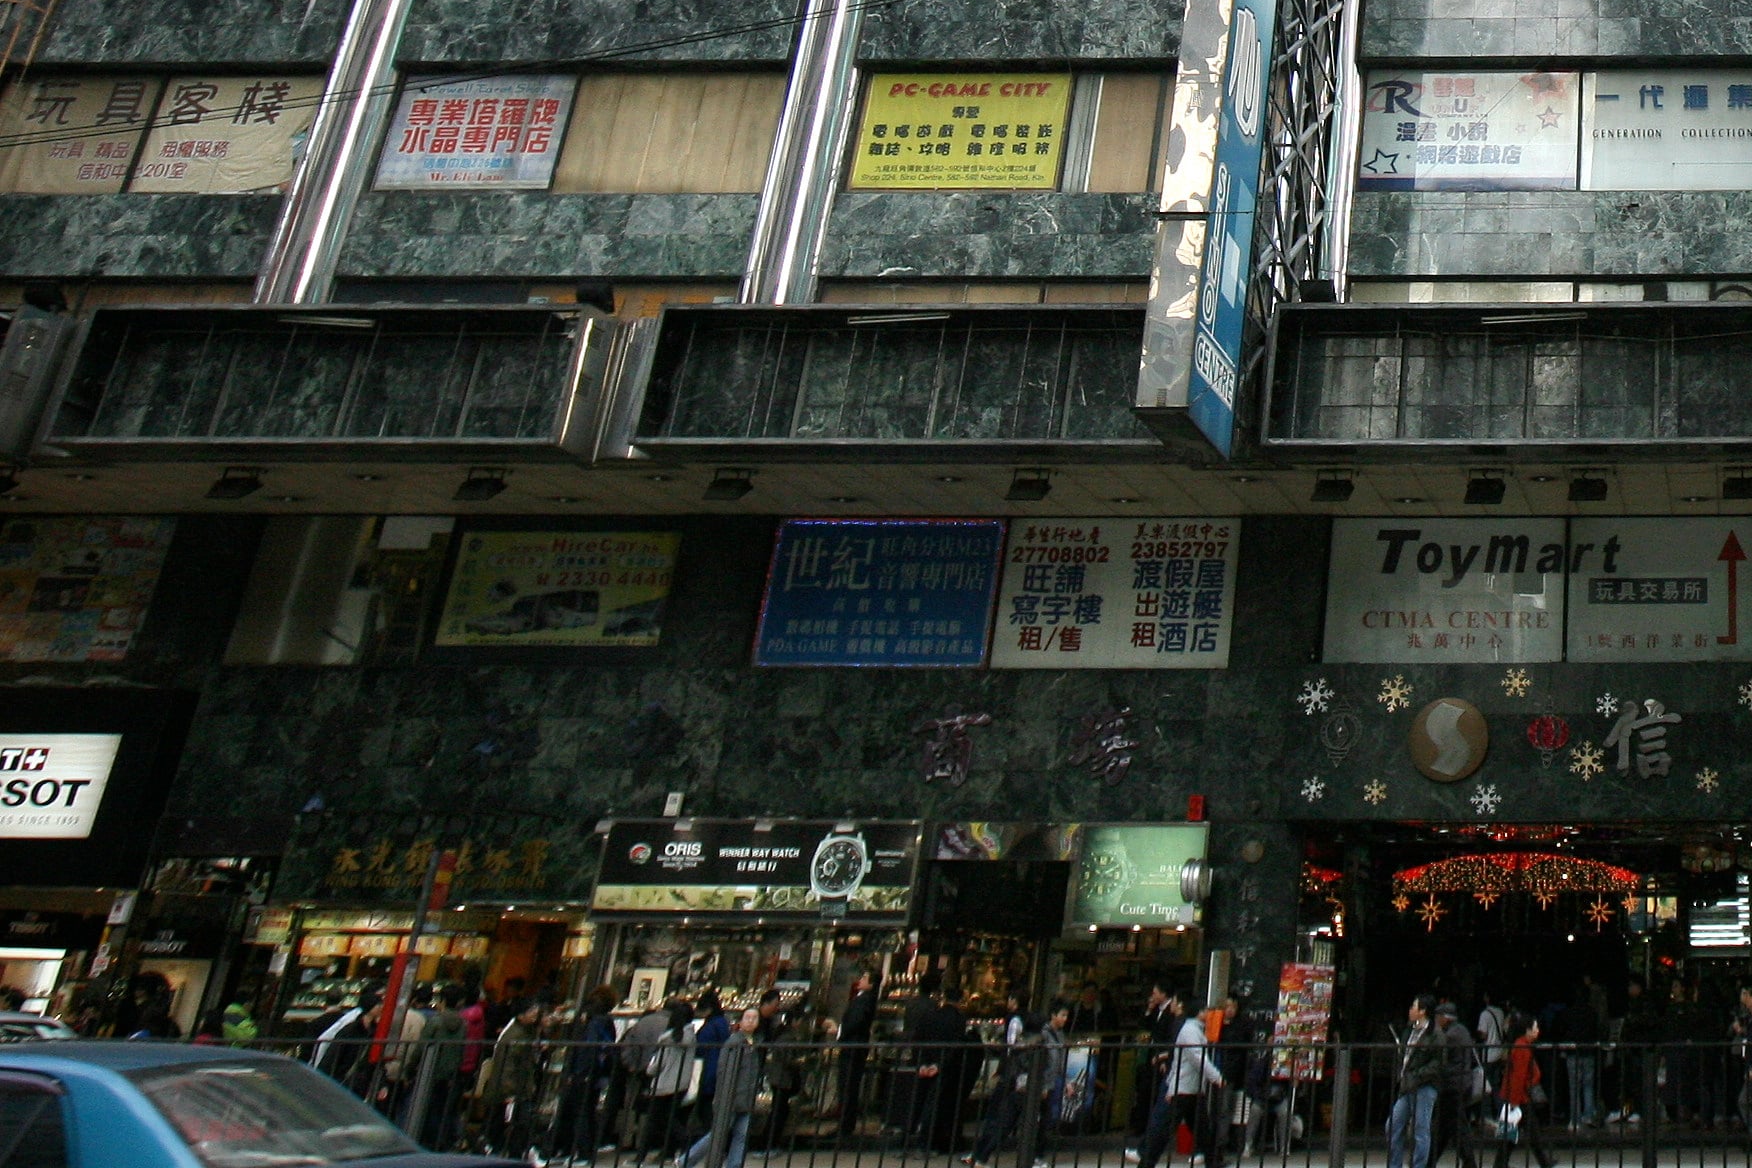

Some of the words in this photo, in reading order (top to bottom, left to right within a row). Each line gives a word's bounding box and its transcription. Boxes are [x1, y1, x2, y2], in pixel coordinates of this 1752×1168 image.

[888, 82, 992, 98] PC-GAME
[999, 82, 1054, 98] CITY
[407, 98, 561, 126] 專業塔羅牌
[399, 126, 553, 154] 水晶專門店
[1592, 128, 1663, 139] GENERATION
[1194, 333, 1237, 413] CENTRE
[1011, 546, 1110, 563] 27708802
[1131, 542, 1229, 559] 23852797
[785, 536, 876, 592] 世紀
[1132, 559, 1226, 590] 渡假屋
[878, 562, 986, 592] 音響專門店
[1594, 579, 1704, 602] 玩具交易所
[1009, 594, 1104, 625] 寫字樓
[1361, 609, 1436, 631] CTMA
[1447, 608, 1551, 631] CENTRE
[1017, 625, 1083, 653] 租/售
[0, 778, 92, 808] SOT
[19, 814, 52, 826] SINCE
[664, 842, 701, 857] ORIS
[718, 847, 751, 858] WINNER
[752, 847, 771, 858] WAY
[772, 847, 801, 858] WATCH
[1119, 903, 1147, 915] Cute
[1149, 903, 1179, 916] Time
